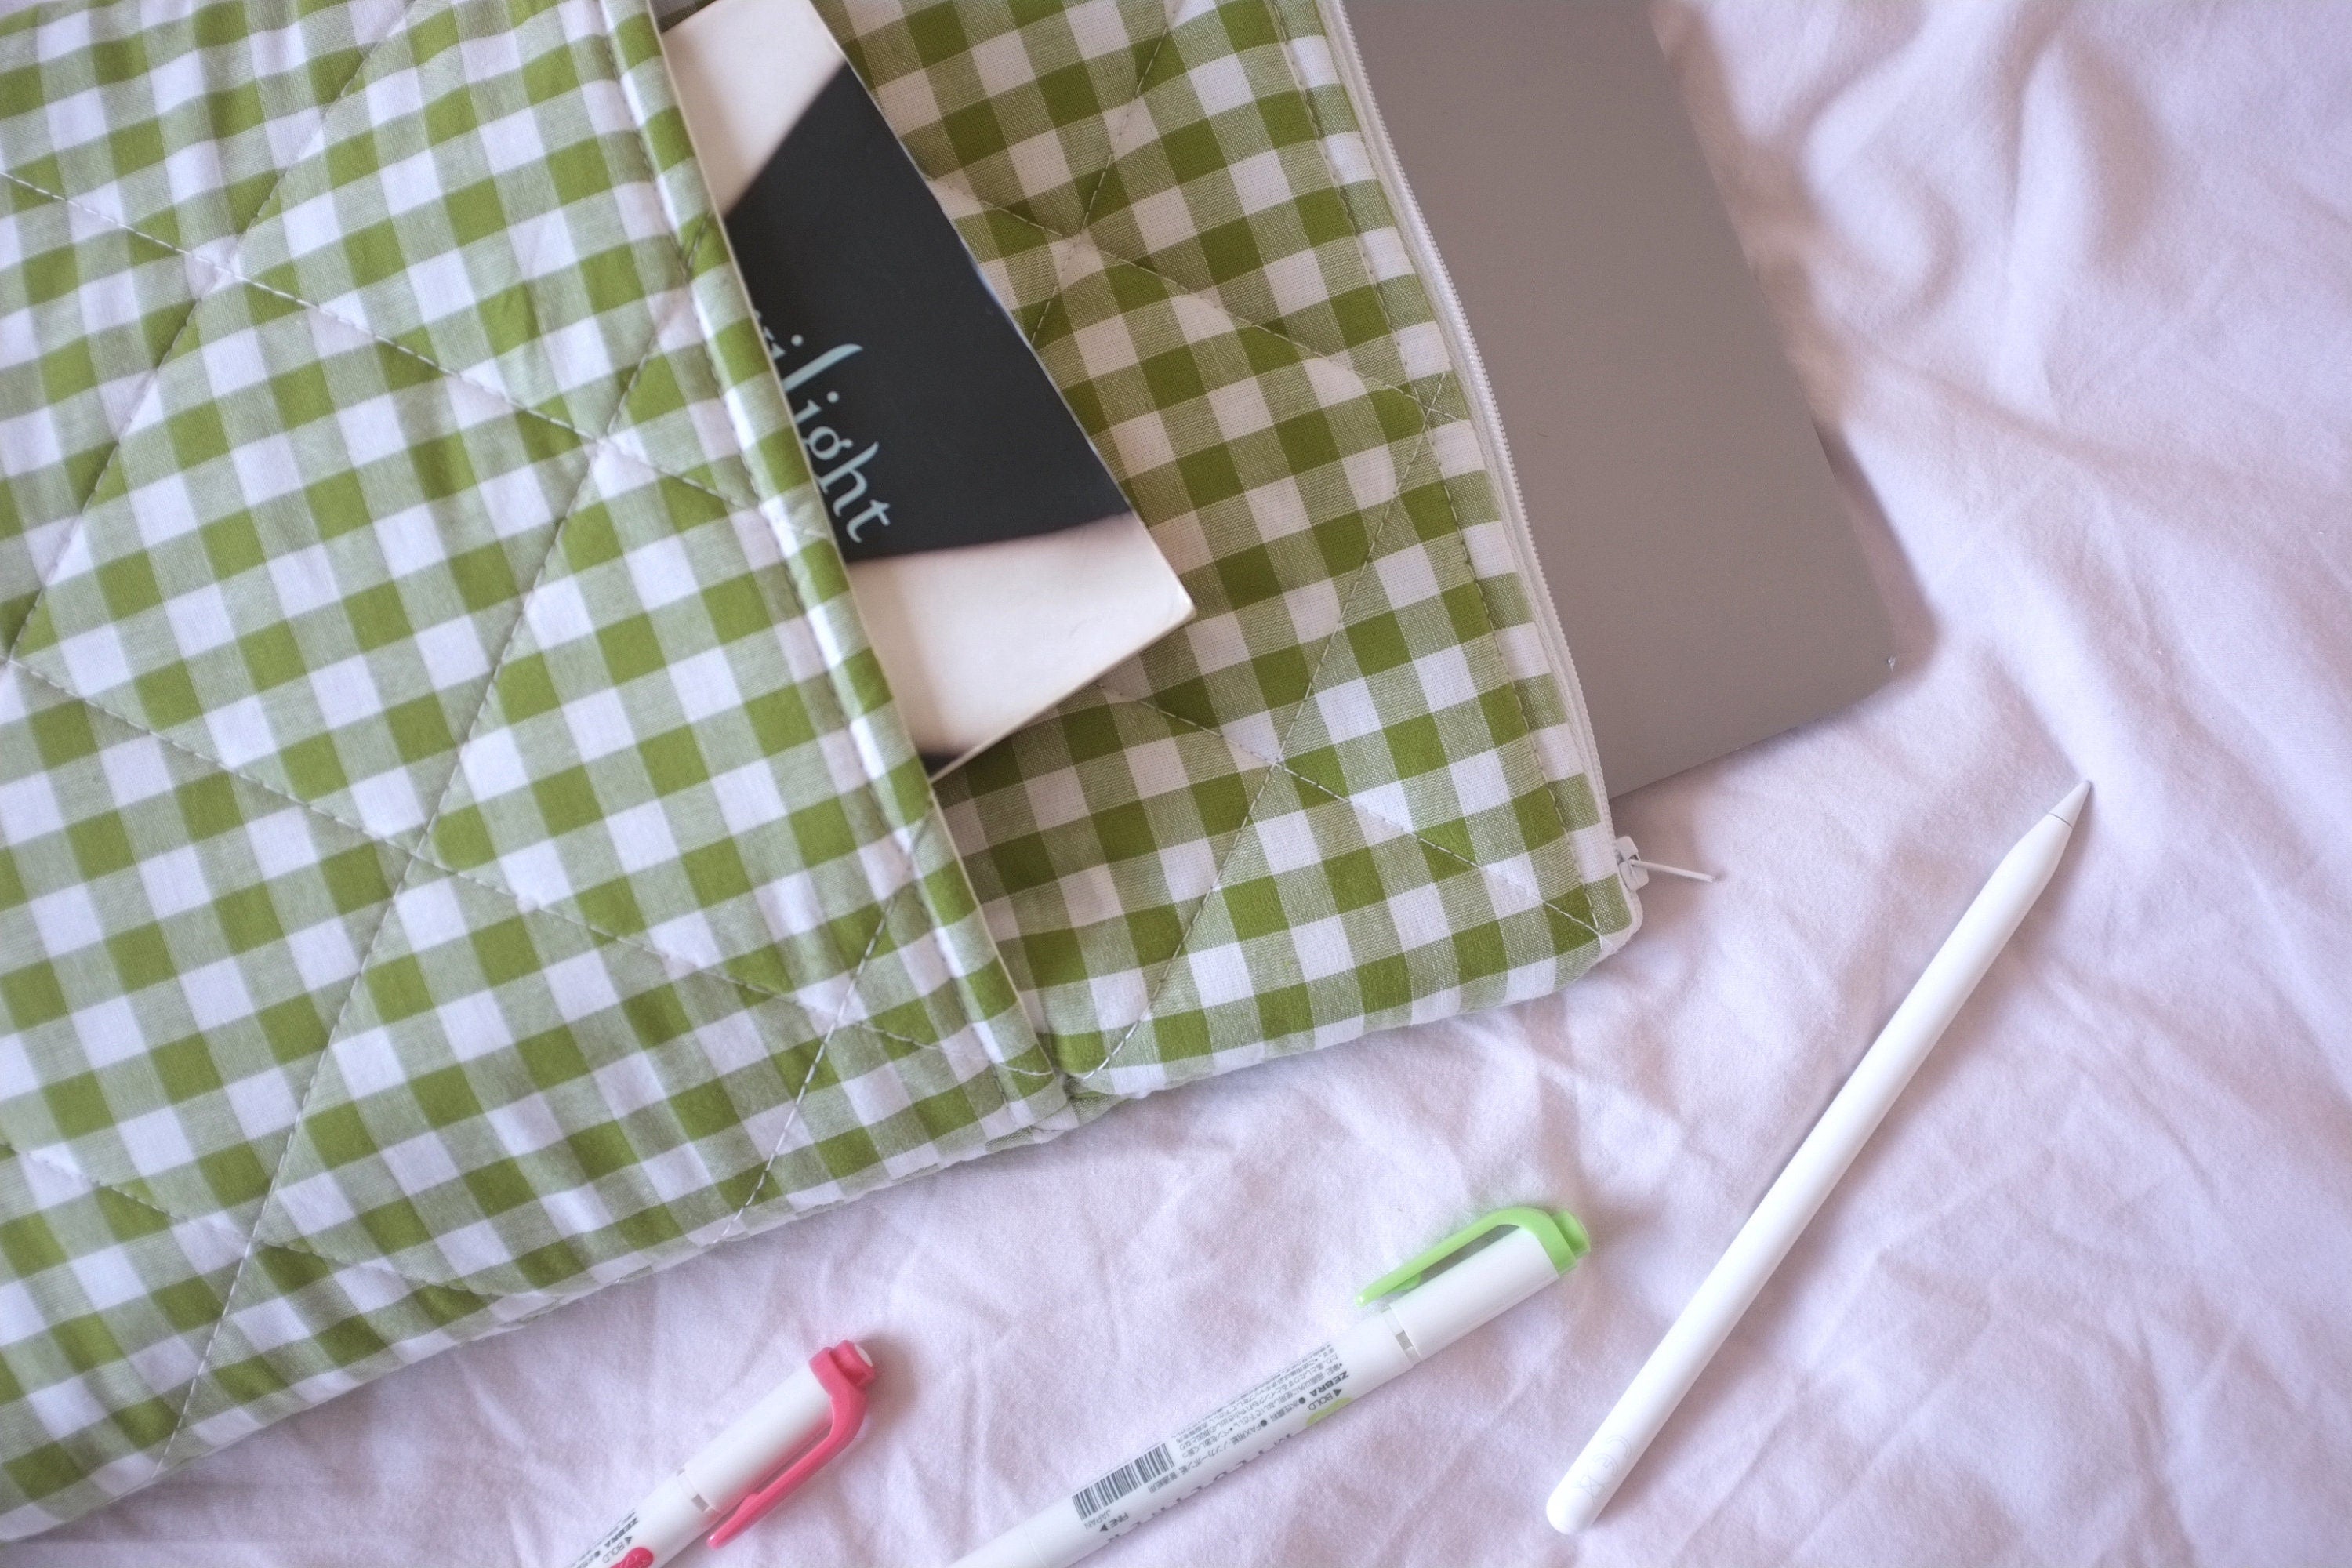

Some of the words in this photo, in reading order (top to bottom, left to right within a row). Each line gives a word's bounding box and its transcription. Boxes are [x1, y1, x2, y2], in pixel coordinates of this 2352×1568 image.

[1308, 1370, 1349, 1398] ZEBRA
[1307, 1392, 1333, 1411] BOLD
[1083, 1508, 1112, 1530] JAPAN
[1108, 1512, 1129, 1528] FINE
[604, 1517, 638, 1548] ZEBRA
[602, 1541, 625, 1563] BOLD
